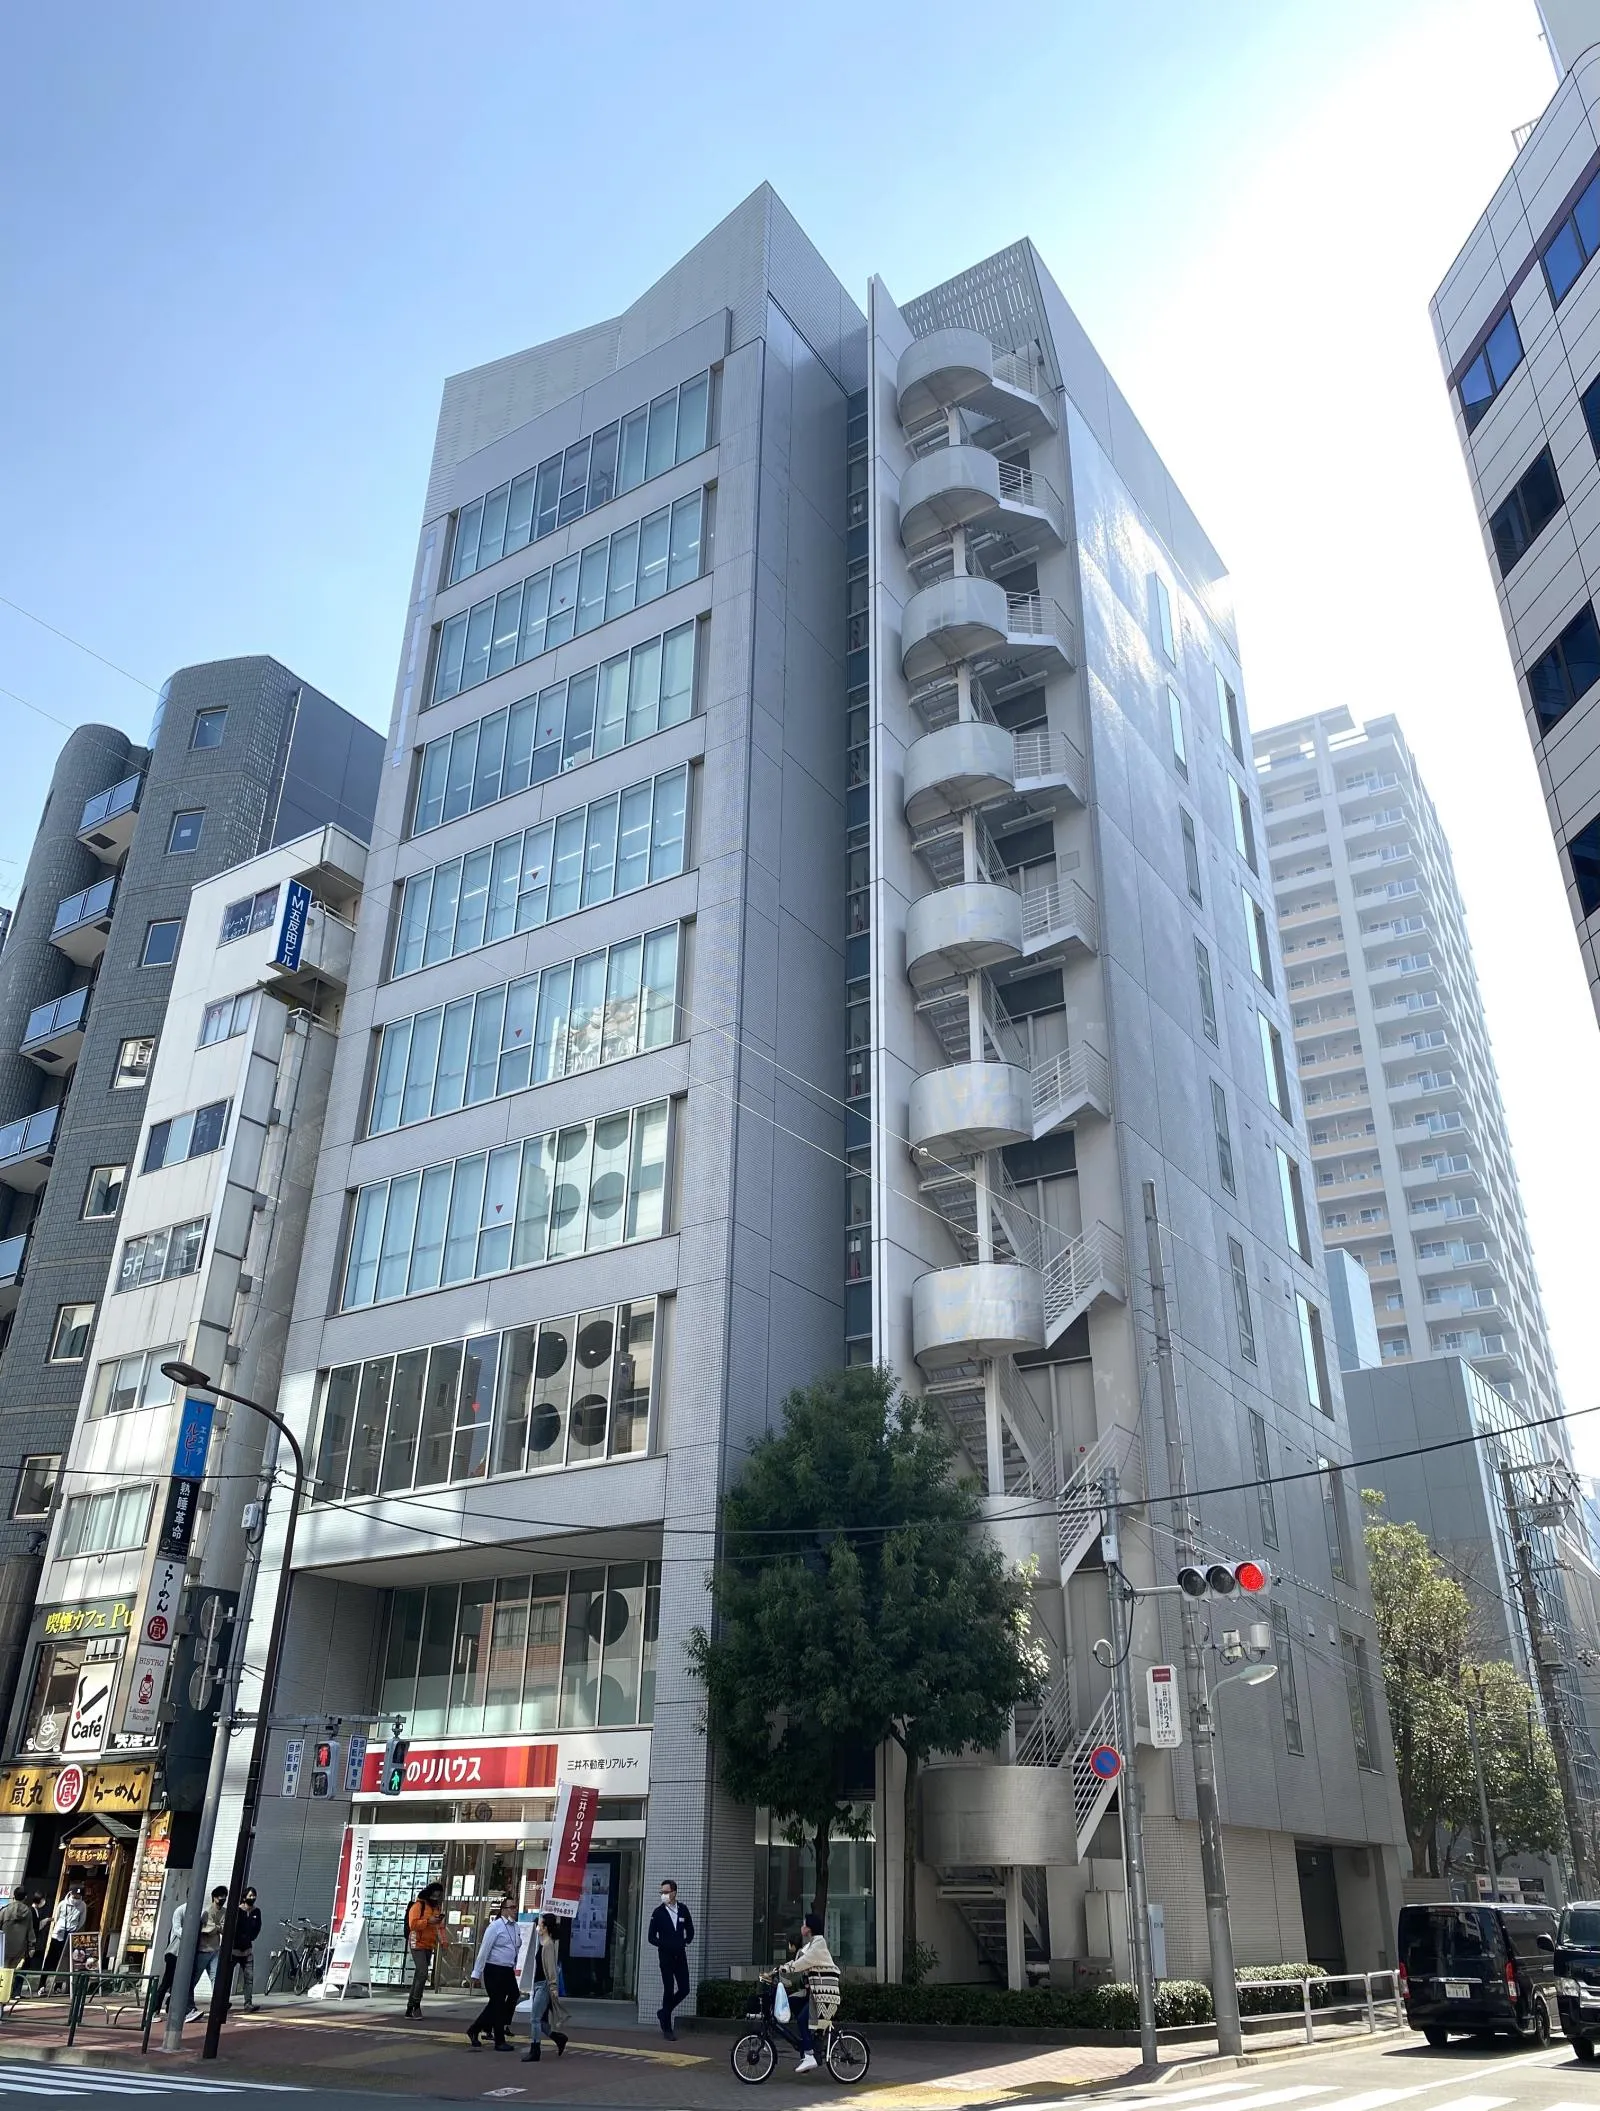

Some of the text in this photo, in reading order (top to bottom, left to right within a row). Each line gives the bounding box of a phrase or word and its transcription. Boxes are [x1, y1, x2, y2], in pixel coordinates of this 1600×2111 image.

[156, 1564, 174, 1613] らーめん
[44, 1609, 106, 1635] 喫煙カフェ
[138, 1657, 166, 1668] BISTRO
[1161, 1684, 1170, 1729] 三井のリハウス
[71, 1714, 103, 1739] Café
[376, 1756, 639, 1785] のリハウス 三井不動産リアルティ
[93, 1777, 142, 1805] らーめん
[568, 1790, 590, 1863] 三井のリハウス
